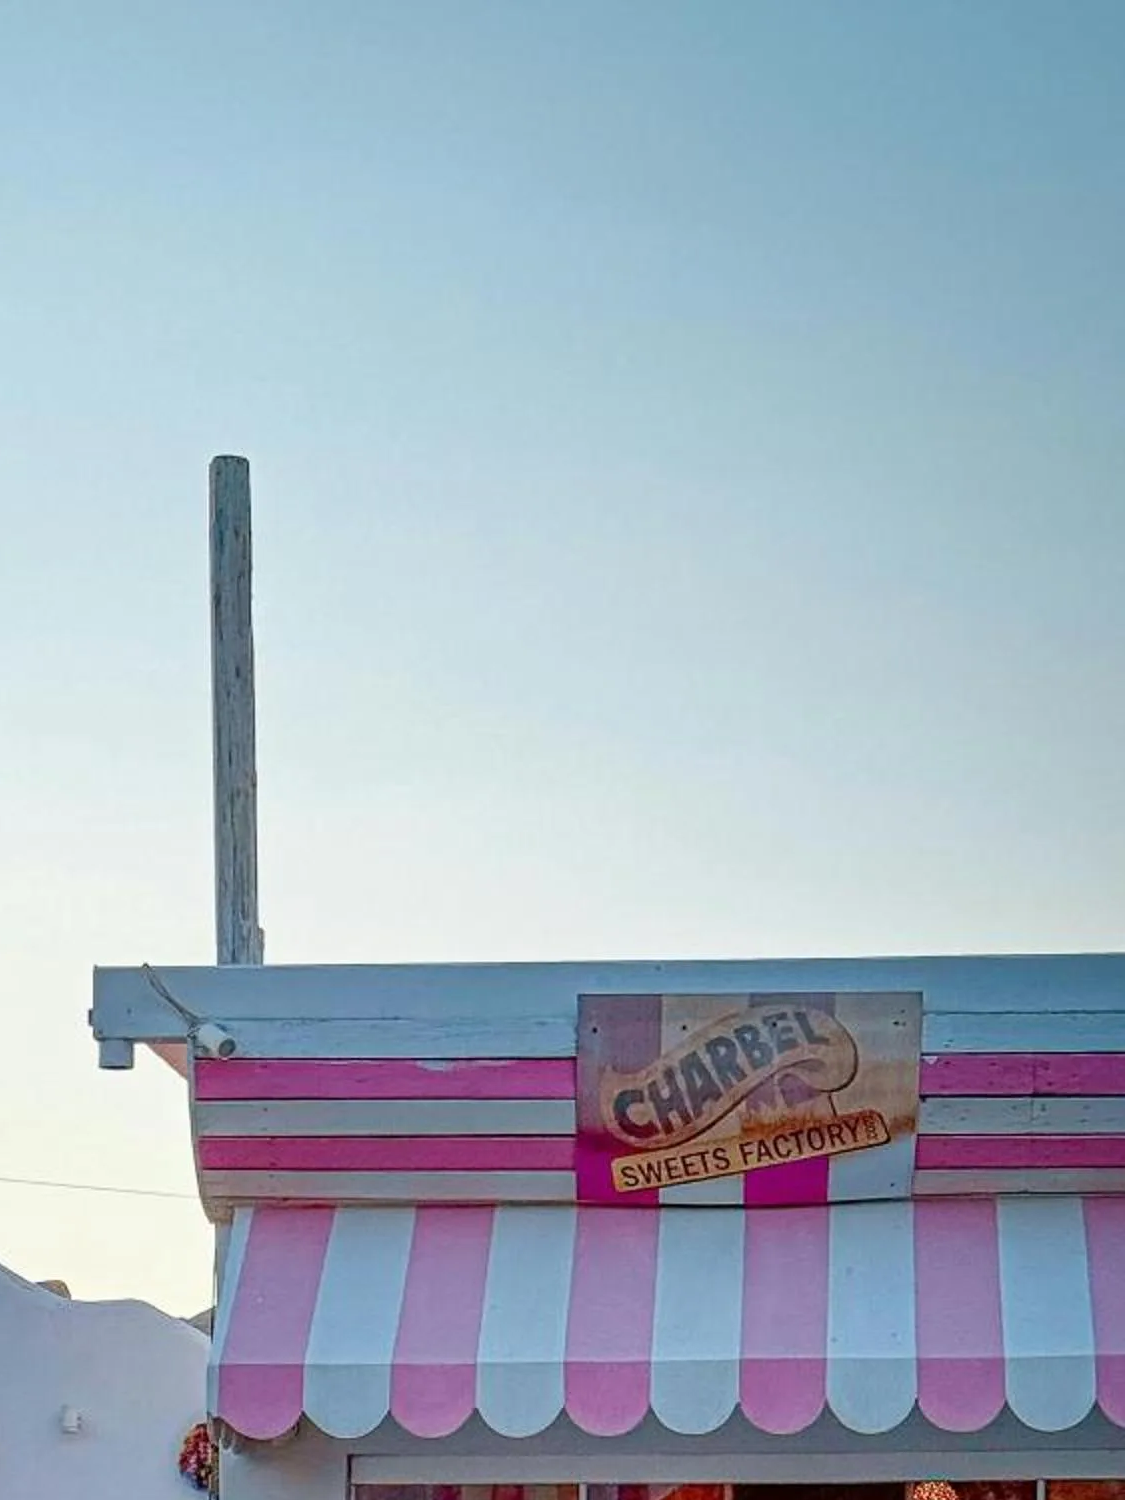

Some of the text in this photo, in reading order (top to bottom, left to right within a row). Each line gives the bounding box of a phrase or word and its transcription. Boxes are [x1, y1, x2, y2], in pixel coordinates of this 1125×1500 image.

[612, 1010, 830, 1140] CHARBEL
[620, 1147, 731, 1188] SWEETS
[738, 1115, 860, 1167] FACTORY
